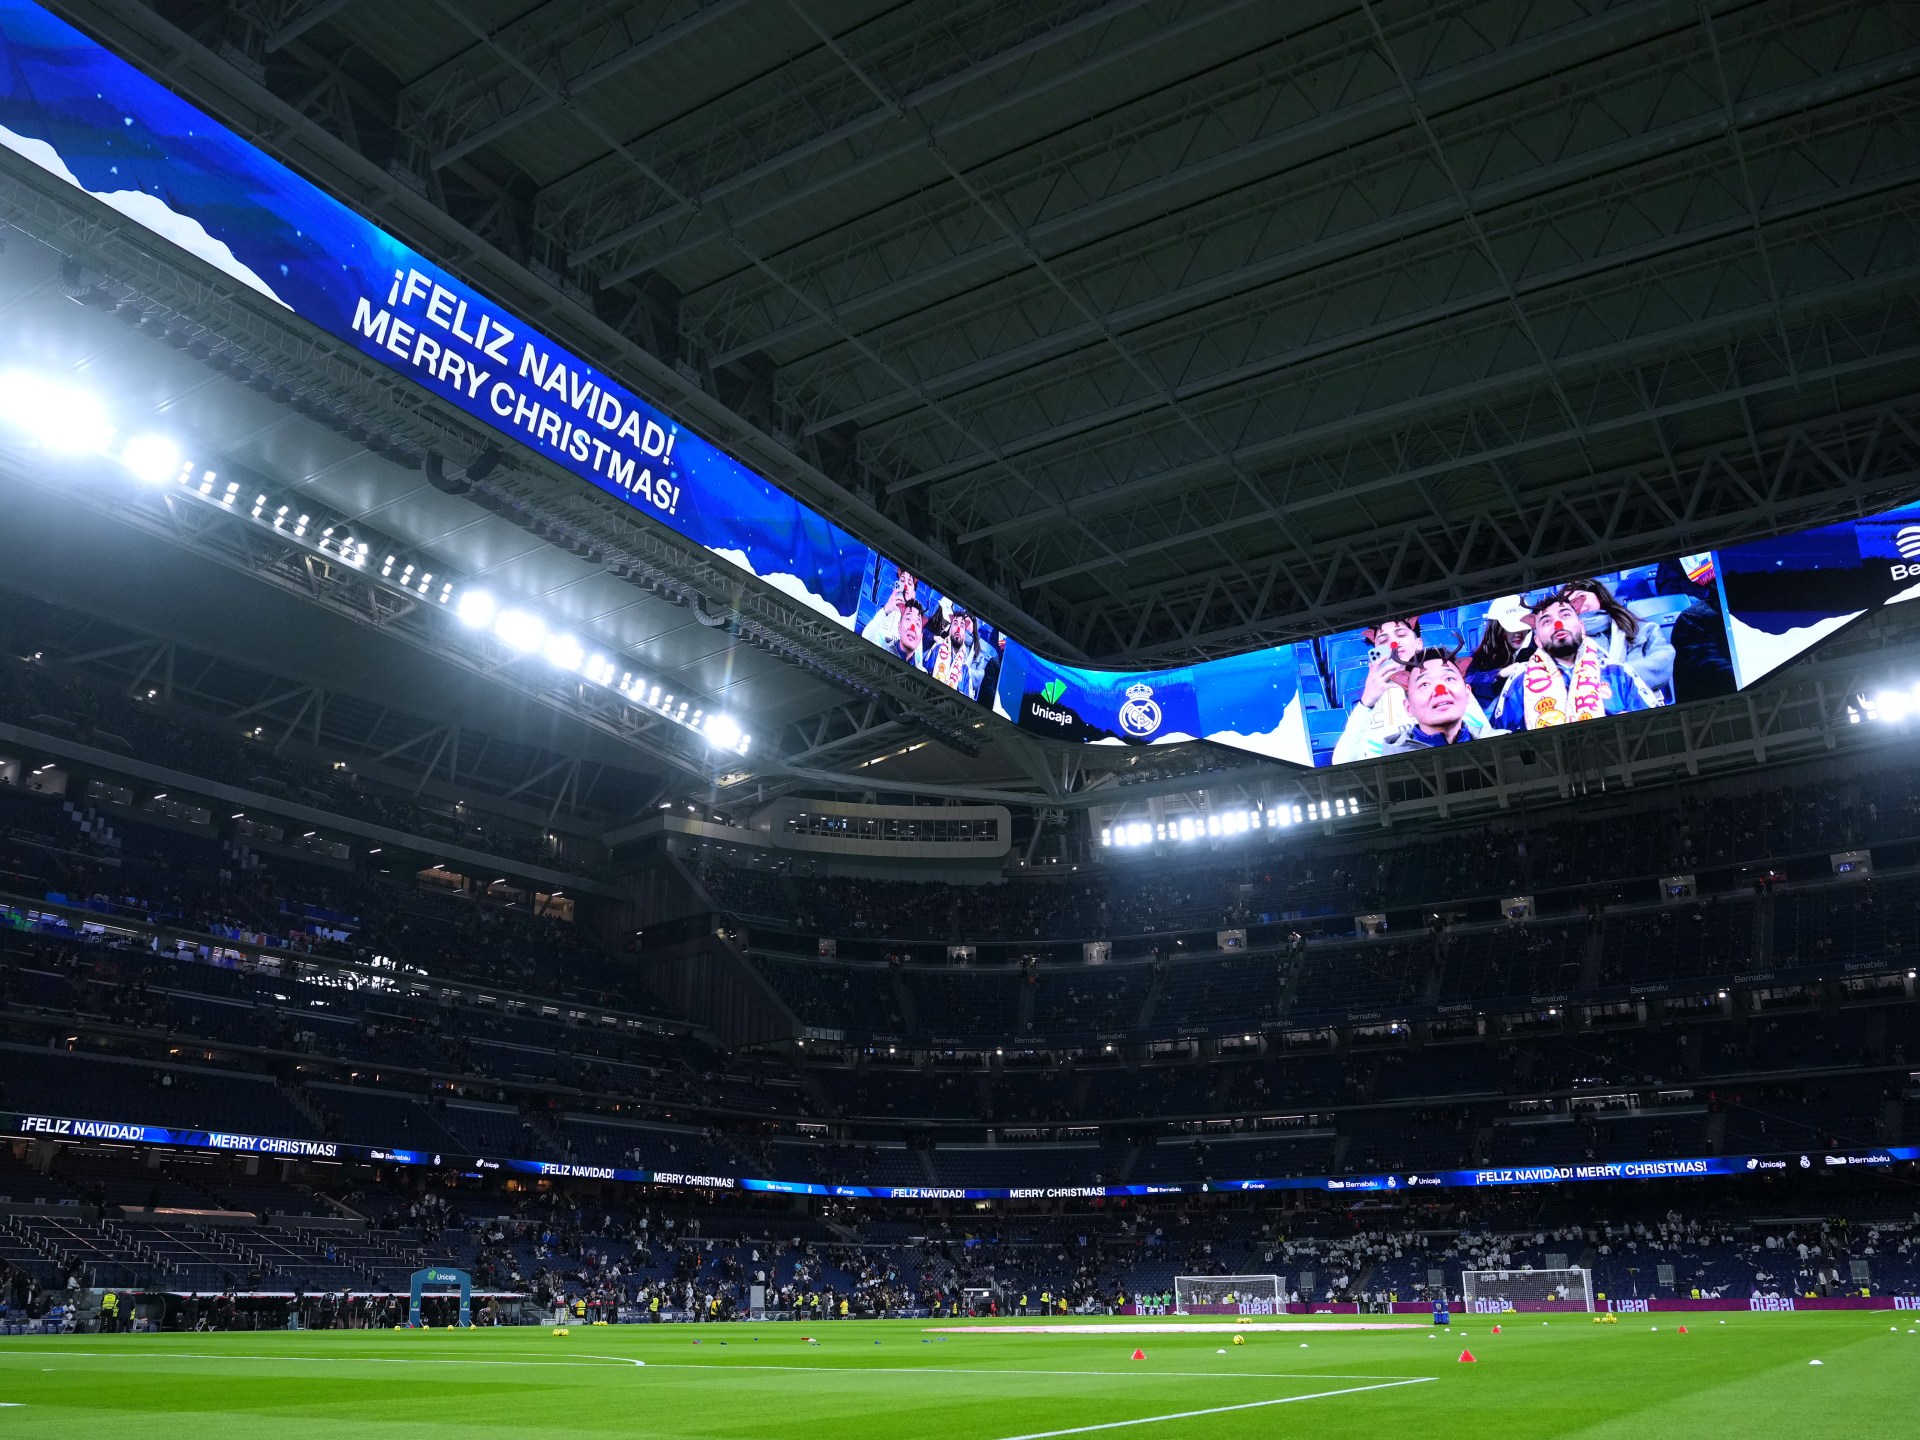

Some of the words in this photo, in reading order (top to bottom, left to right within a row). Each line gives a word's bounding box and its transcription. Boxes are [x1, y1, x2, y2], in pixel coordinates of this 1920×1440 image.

[387, 267, 515, 366] ¡FELIZ
[518, 342, 676, 467] NAVIDAD!
[351, 296, 491, 399] MERRY
[490, 380, 681, 516] CHRISTMAS!
[1031, 702, 1073, 727] Unicaja
[21, 1117, 71, 1134] ¡FELIZ
[73, 1121, 145, 1141] NAVIDAD!
[208, 1133, 258, 1149] MERRY
[259, 1138, 337, 1158] CHRISTMAS!
[541, 1163, 571, 1176] ¡FELIZ
[571, 1165, 615, 1179] NAVIDAD!
[1475, 1169, 1513, 1183] ¡FELIZ
[1515, 1166, 1574, 1182] NAVIDAD!
[1576, 1165, 1622, 1179] MERRY
[1624, 1161, 1708, 1177] CHRISTMAS!
[1759, 1159, 1787, 1170] Unicaja
[653, 1172, 685, 1185] MERRY
[685, 1175, 735, 1189] CHRISTMAS!
[890, 1188, 919, 1198] ¡FELIZ
[920, 1187, 966, 1199] NAVIDAD!
[1009, 1188, 1045, 1198] MERRY
[1046, 1186, 1106, 1198] CHRISTMAS!
[436, 1273, 457, 1282] Unicaja
